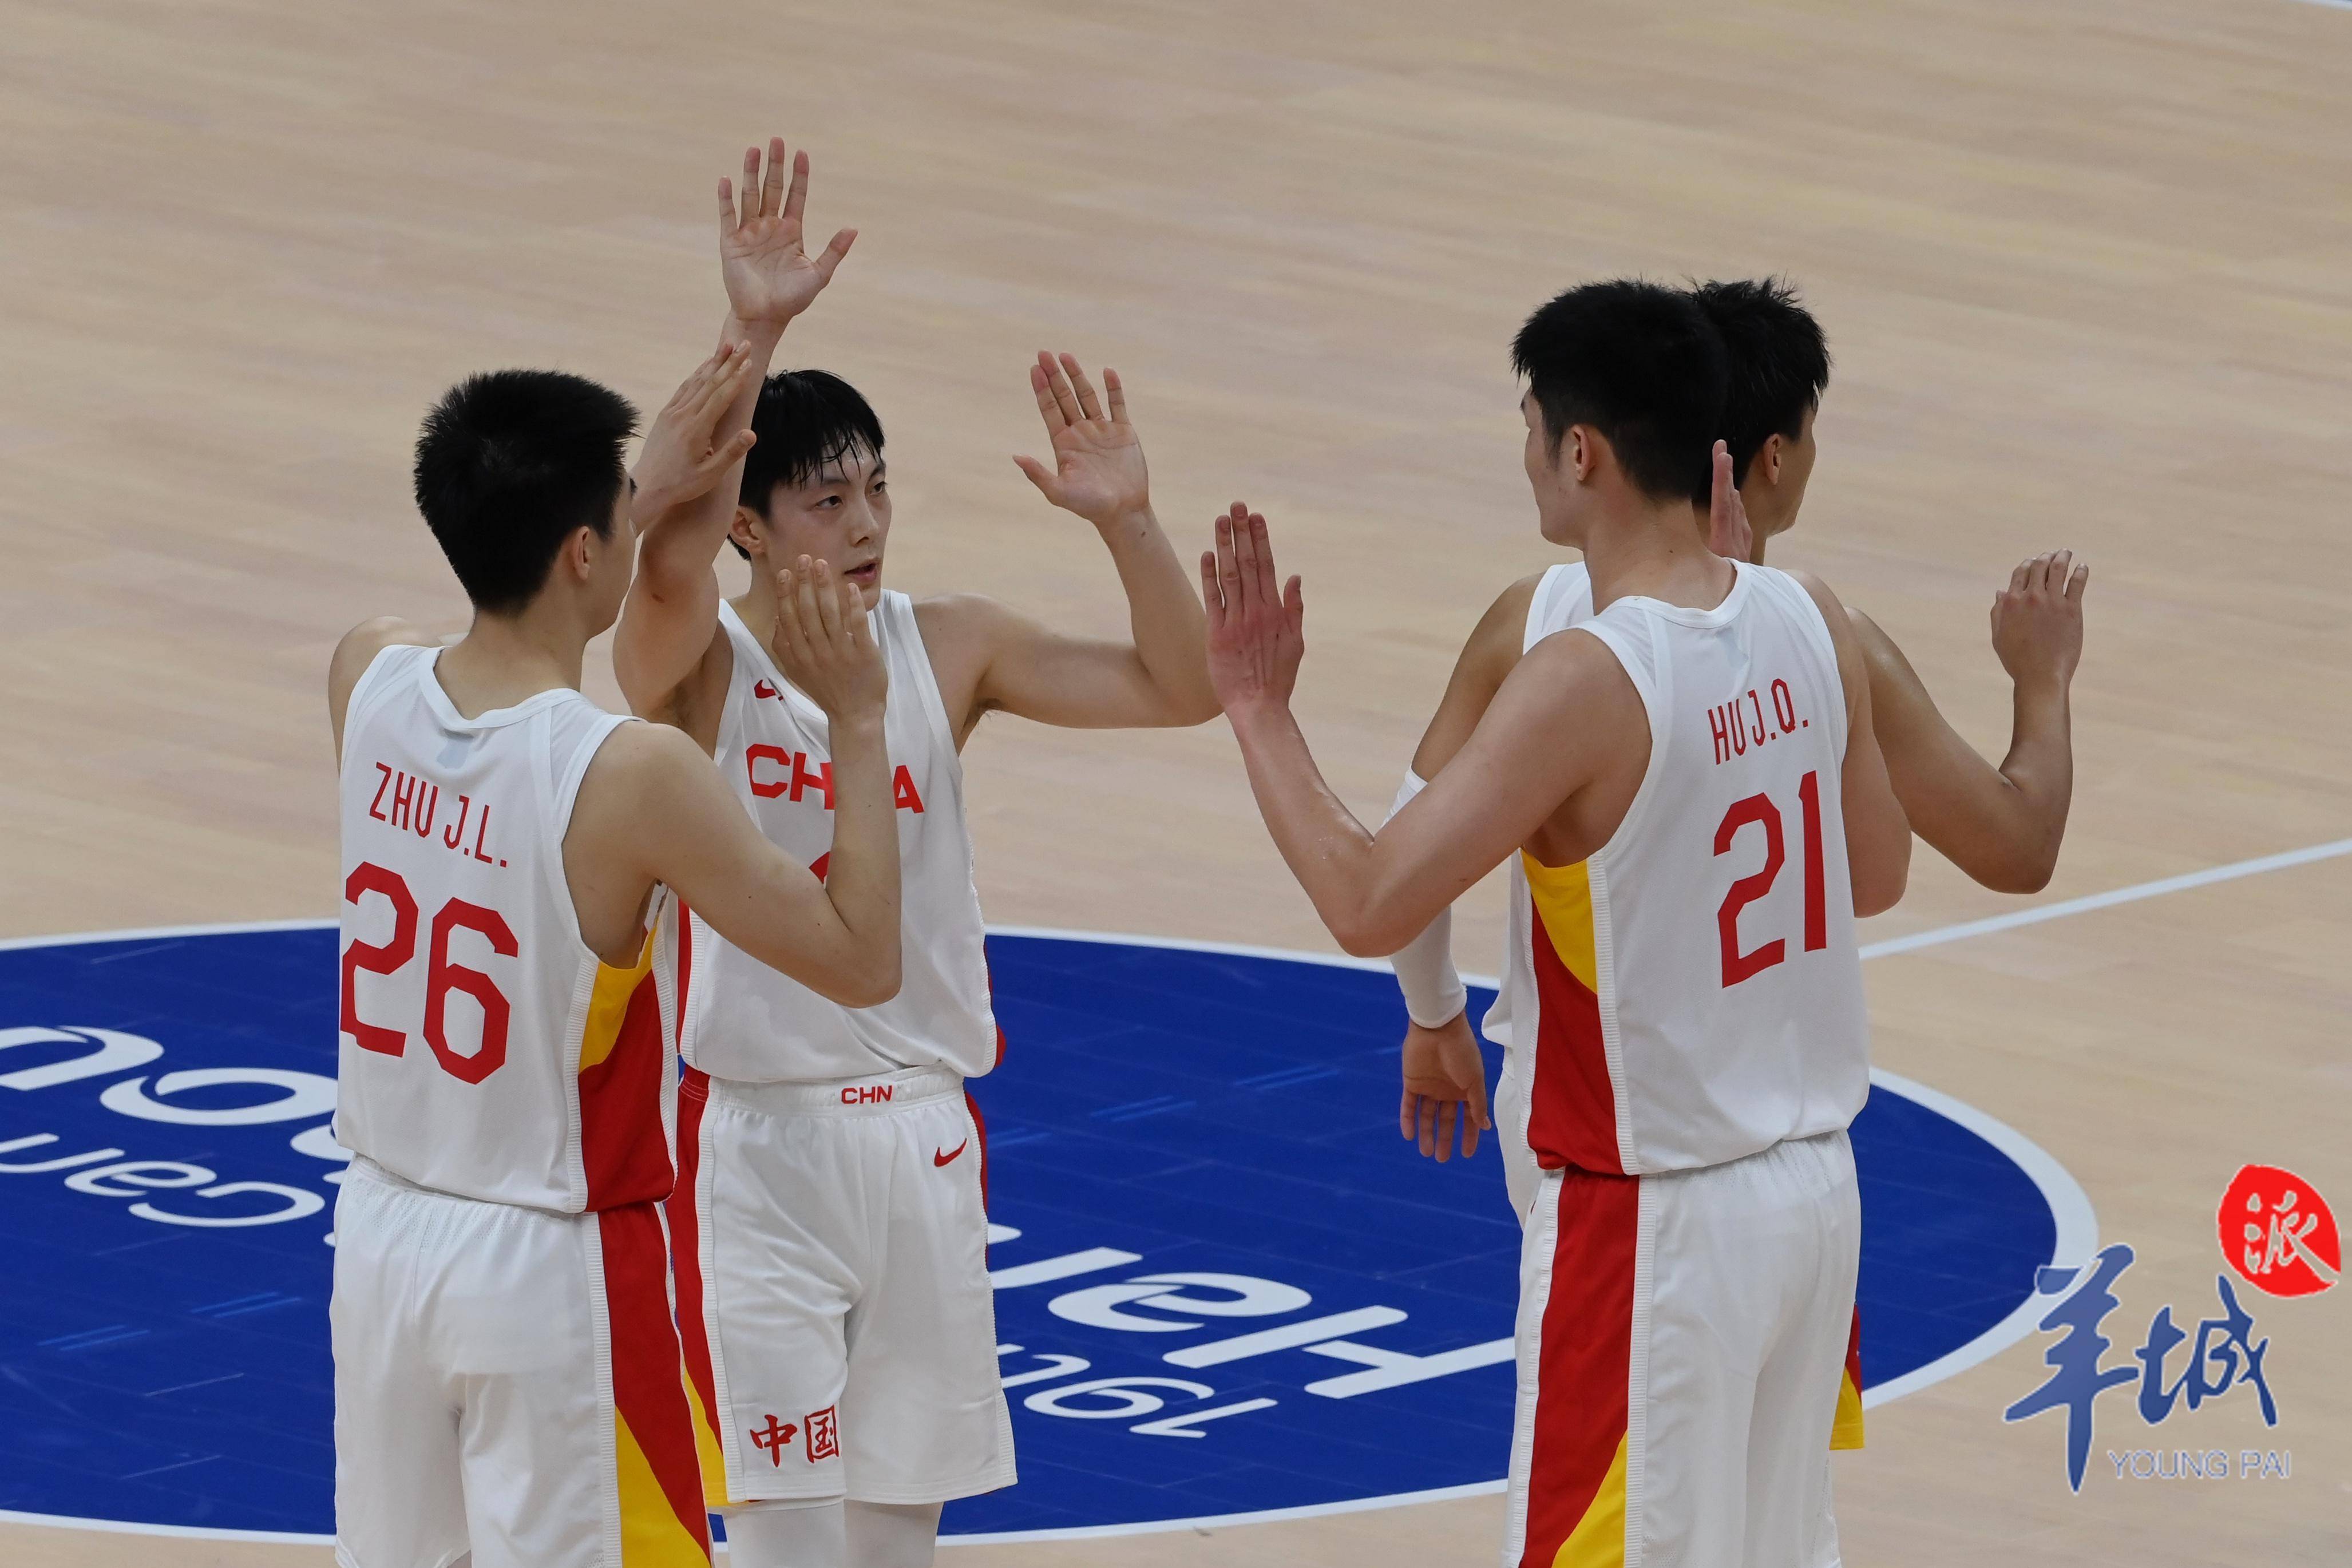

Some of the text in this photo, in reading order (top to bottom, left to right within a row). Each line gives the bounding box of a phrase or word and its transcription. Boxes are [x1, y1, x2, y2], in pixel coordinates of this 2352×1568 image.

[1708, 678, 1809, 765] HU J.Q.
[369, 761, 507, 868] ZHU J.L.
[745, 743, 925, 814] CHA
[1713, 770, 1827, 989] 21
[340, 861, 518, 1085] 26
[841, 1085, 893, 1104] CHN
[749, 1404, 840, 1468] 中国
